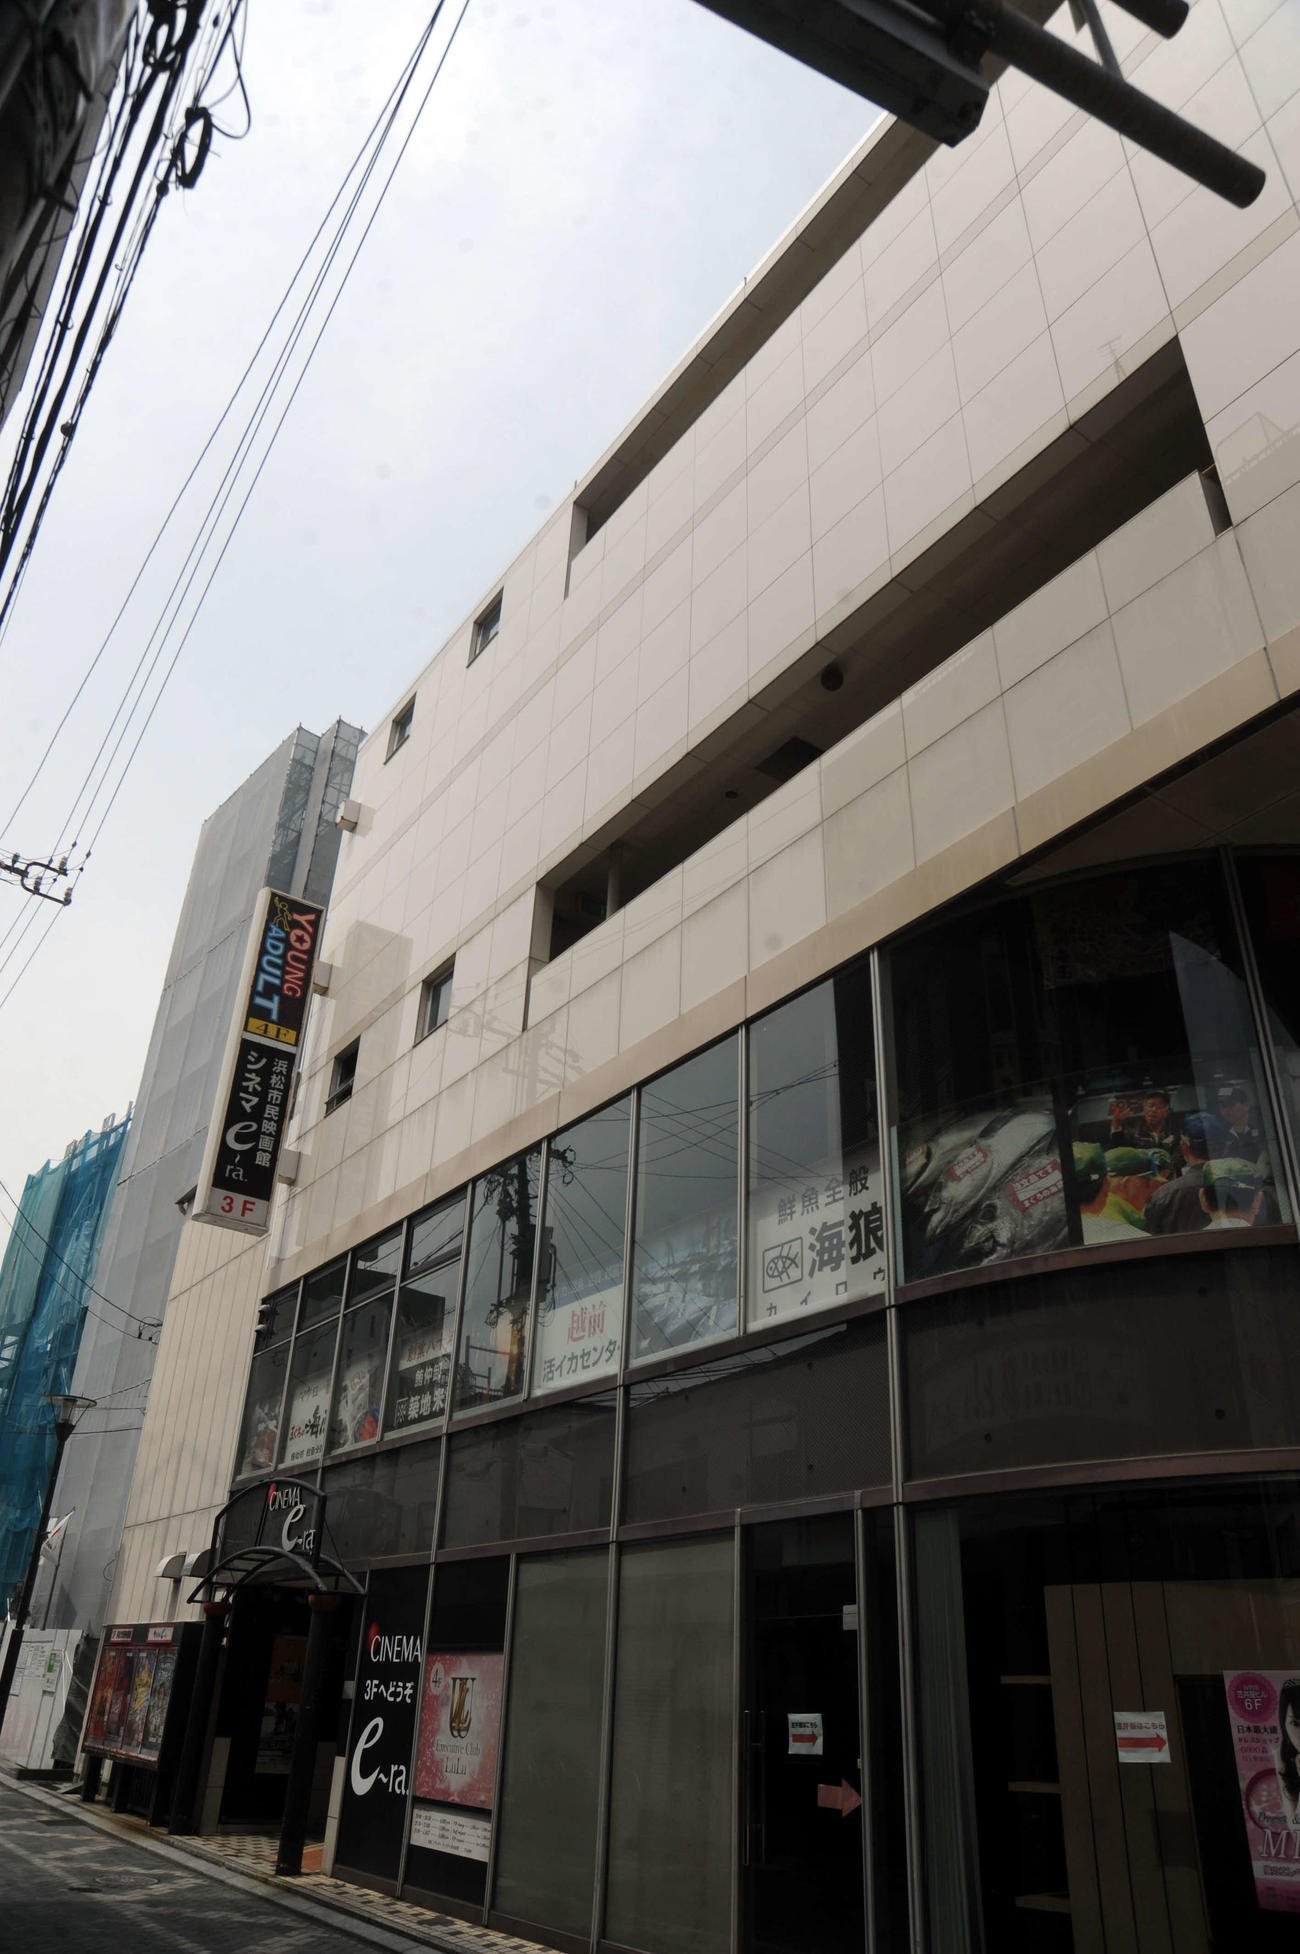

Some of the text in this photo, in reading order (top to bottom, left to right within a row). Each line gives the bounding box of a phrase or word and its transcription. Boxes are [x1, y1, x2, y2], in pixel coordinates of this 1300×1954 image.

[254, 922, 286, 1023] ADULT
[281, 911, 317, 999] YOUNG
[255, 1022, 293, 1043] 4F
[239, 1050, 267, 1114] シネマ
[255, 1058, 288, 1168] 浜松市民映画館
[777, 1165, 870, 1225] 鮮魚全般
[808, 1201, 884, 1279] 海狼
[567, 1300, 607, 1344] 越前
[543, 1338, 622, 1383] 活イカセンタ
[408, 1386, 448, 1421] 築地米
[269, 1487, 300, 1511] CINEMA
[370, 1635, 422, 1663] CINEMA
[364, 1678, 415, 1703] 3Fへどうぞ
[1244, 1698, 1263, 1711] 6F
[435, 1739, 481, 1756] Executive Club
